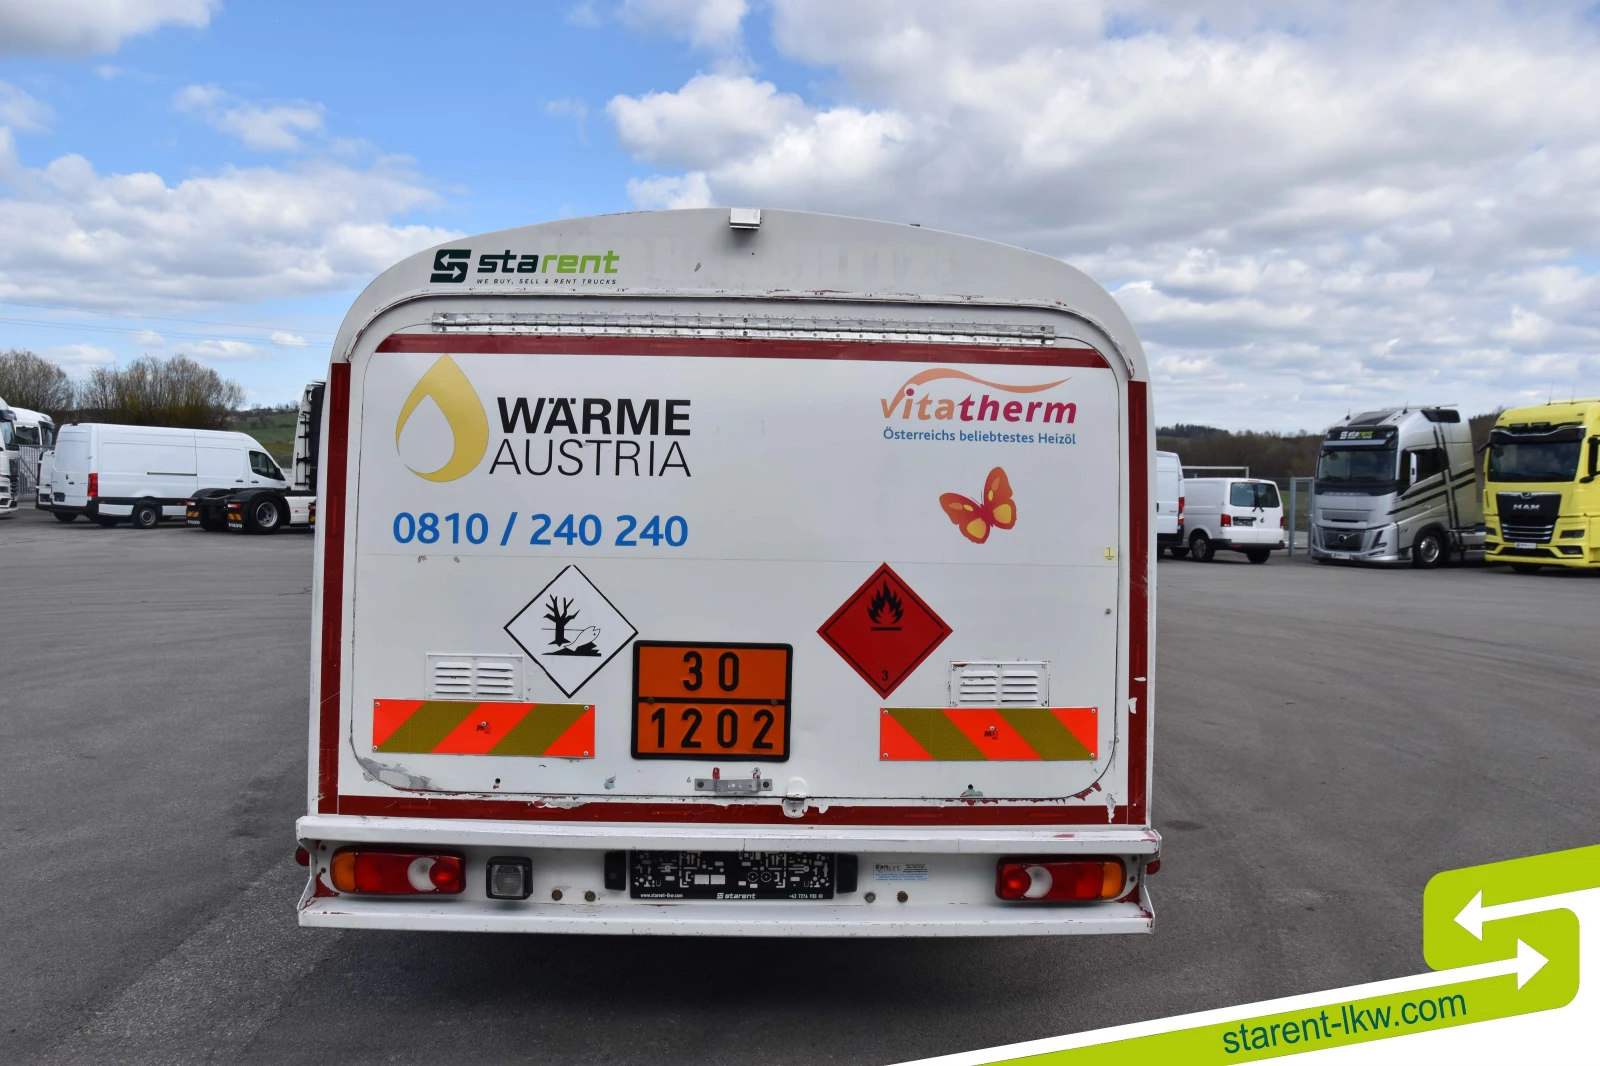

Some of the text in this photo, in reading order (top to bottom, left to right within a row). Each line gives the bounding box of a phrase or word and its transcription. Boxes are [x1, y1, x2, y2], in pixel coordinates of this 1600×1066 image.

[477, 249, 621, 274] starent
[496, 396, 691, 436] WÄRME
[880, 388, 1077, 424] vitatherm
[882, 426, 1077, 445] Österreichs beliebtestes Heizöl
[488, 438, 692, 478] AUSTRIA
[392, 511, 689, 547] 0810 / 240 240
[881, 669, 889, 682] 3
[651, 707, 775, 749] 1202
